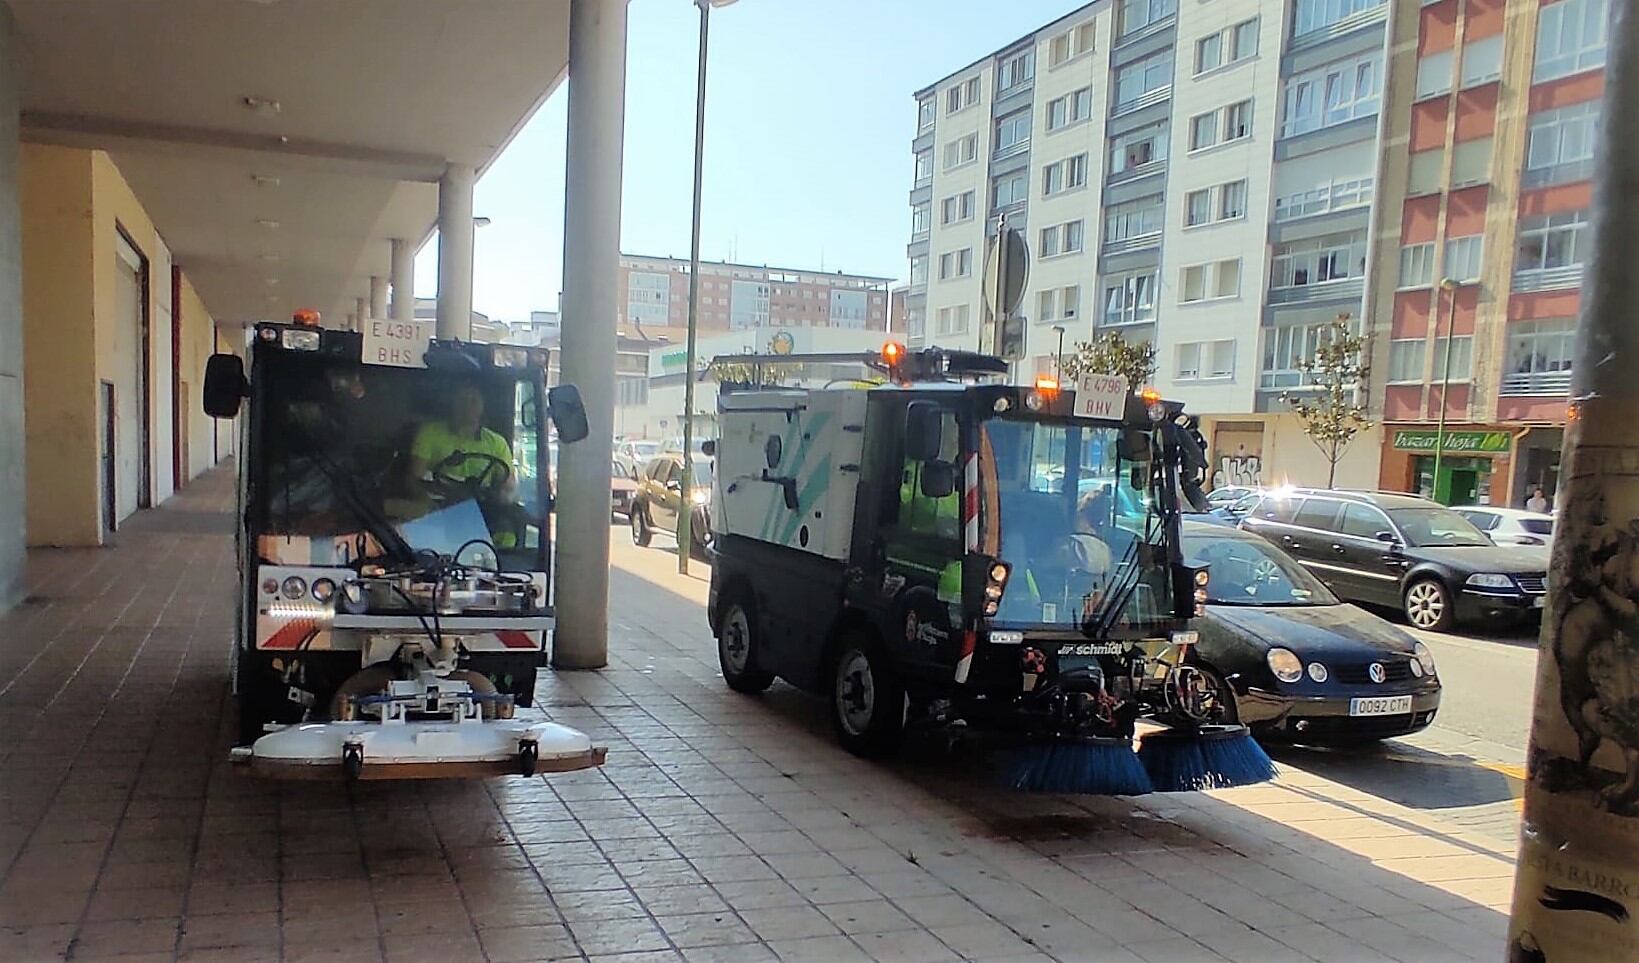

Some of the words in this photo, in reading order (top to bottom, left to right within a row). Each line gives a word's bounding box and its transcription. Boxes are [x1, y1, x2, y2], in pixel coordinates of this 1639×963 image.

[372, 321, 382, 337] E
[386, 323, 421, 341] 4391
[1084, 377, 1092, 391] E
[1094, 379, 1121, 394] 4796
[1076, 643, 1123, 655] schmidt
[1359, 700, 1388, 714] 0092
[1390, 698, 1409, 712] CTH
